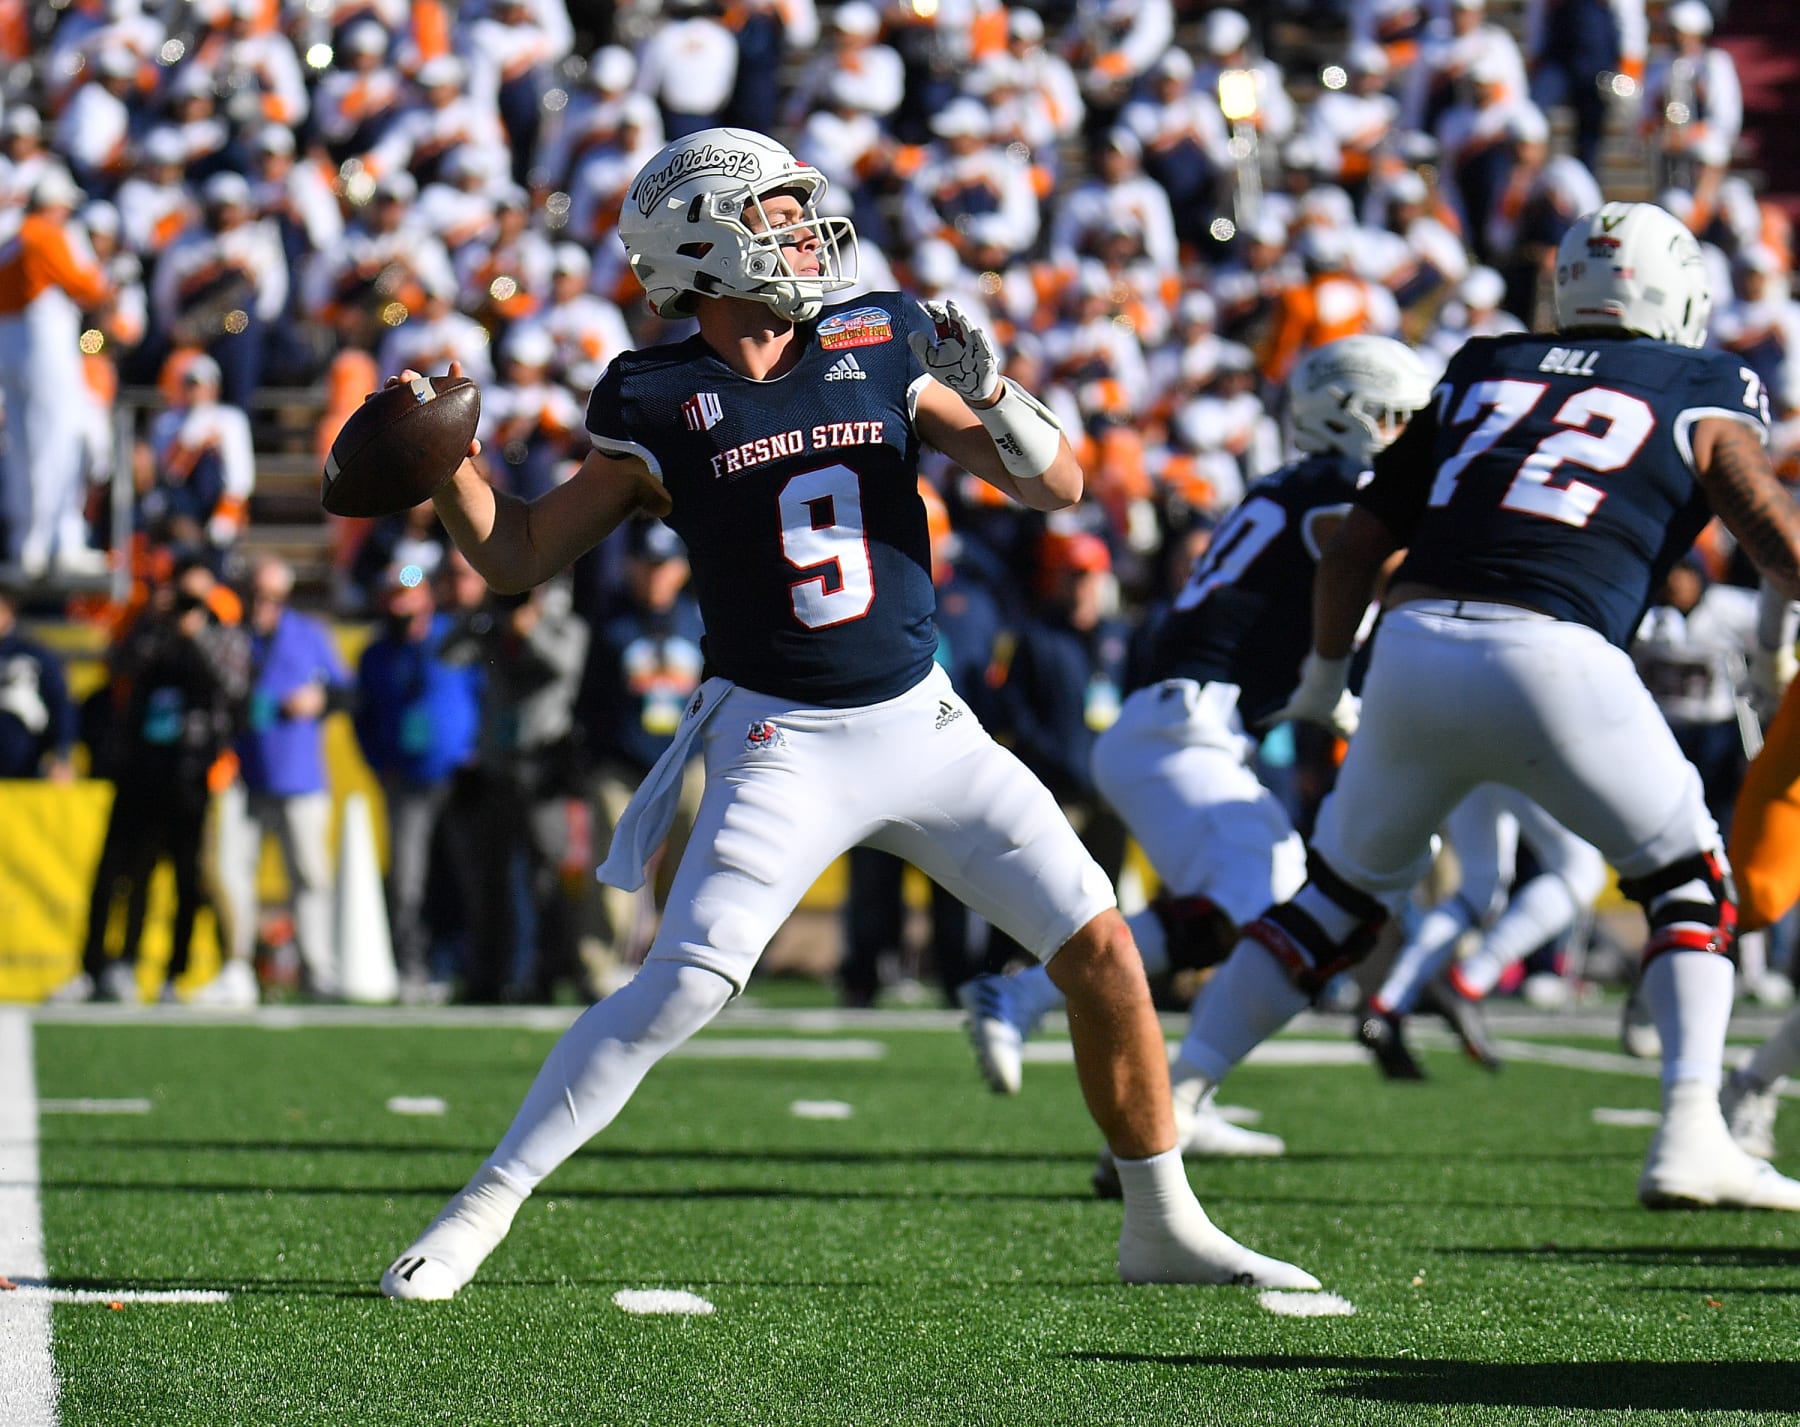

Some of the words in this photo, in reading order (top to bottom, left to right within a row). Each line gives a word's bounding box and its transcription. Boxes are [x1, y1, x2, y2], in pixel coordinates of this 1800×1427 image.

[635, 144, 762, 217] Bulldogs
[824, 369, 867, 382] adidas
[1539, 347, 1600, 376] BULL
[710, 429, 804, 479] FRESNO
[812, 421, 883, 450] STATE
[1427, 378, 1655, 529] 72
[774, 460, 876, 633] 9
[935, 709, 963, 730] adidas
